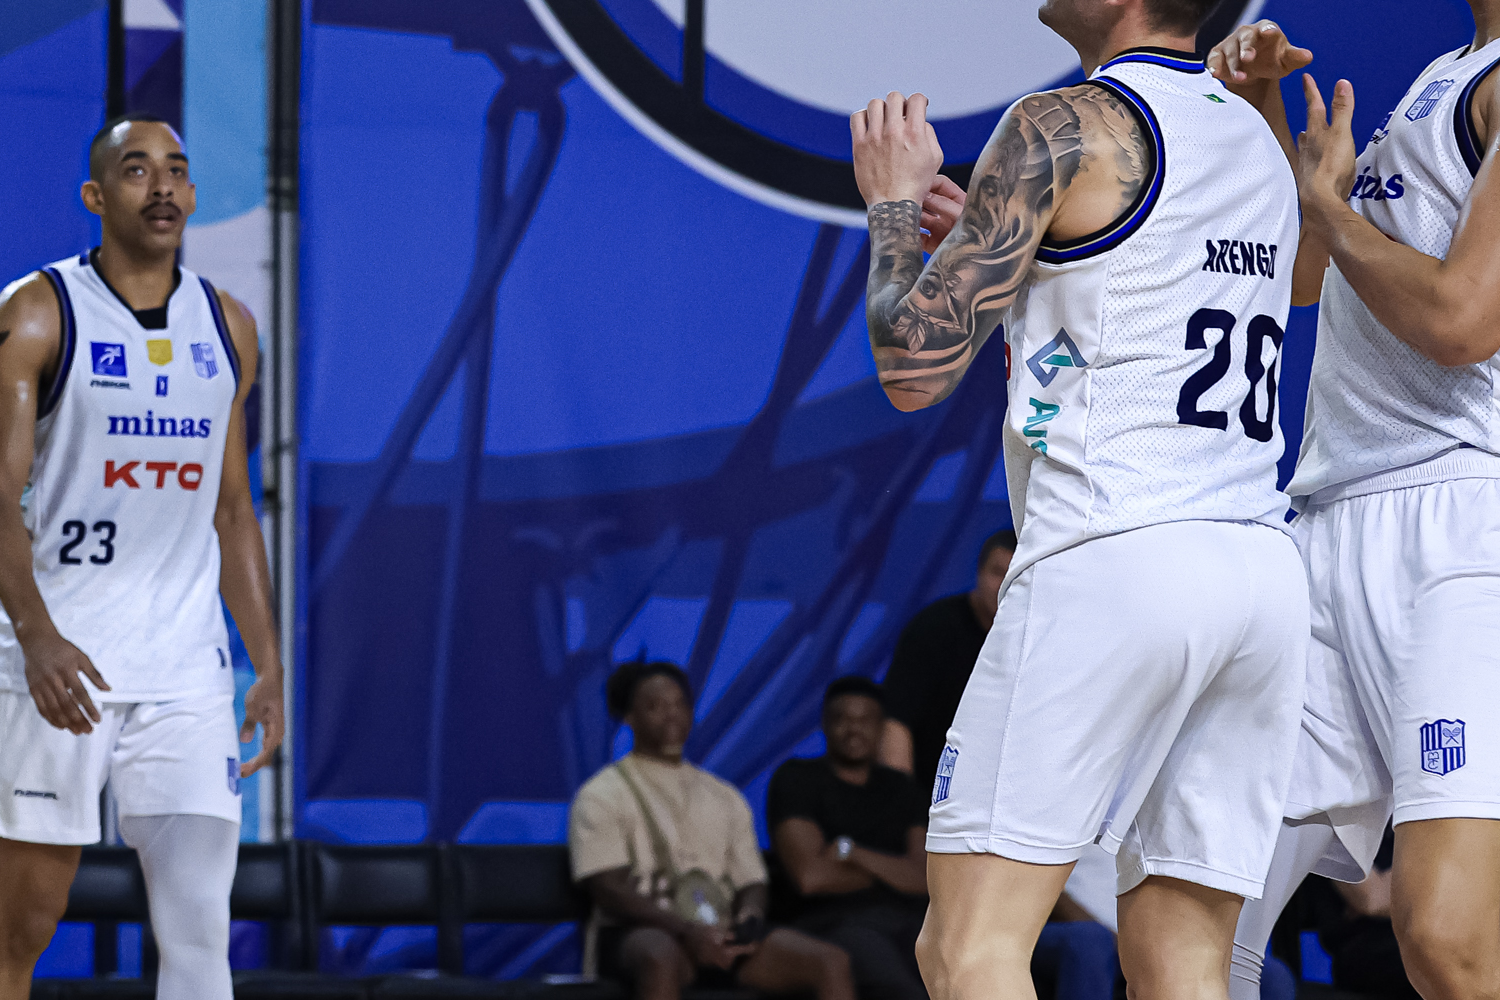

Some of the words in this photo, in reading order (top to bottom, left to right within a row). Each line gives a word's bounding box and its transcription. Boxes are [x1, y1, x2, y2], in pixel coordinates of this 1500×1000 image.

[1201, 238, 1278, 280] ARENGO
[1176, 307, 1285, 443] 20
[107, 410, 212, 438] minas
[104, 460, 204, 492] KTO
[59, 519, 118, 566] 23
